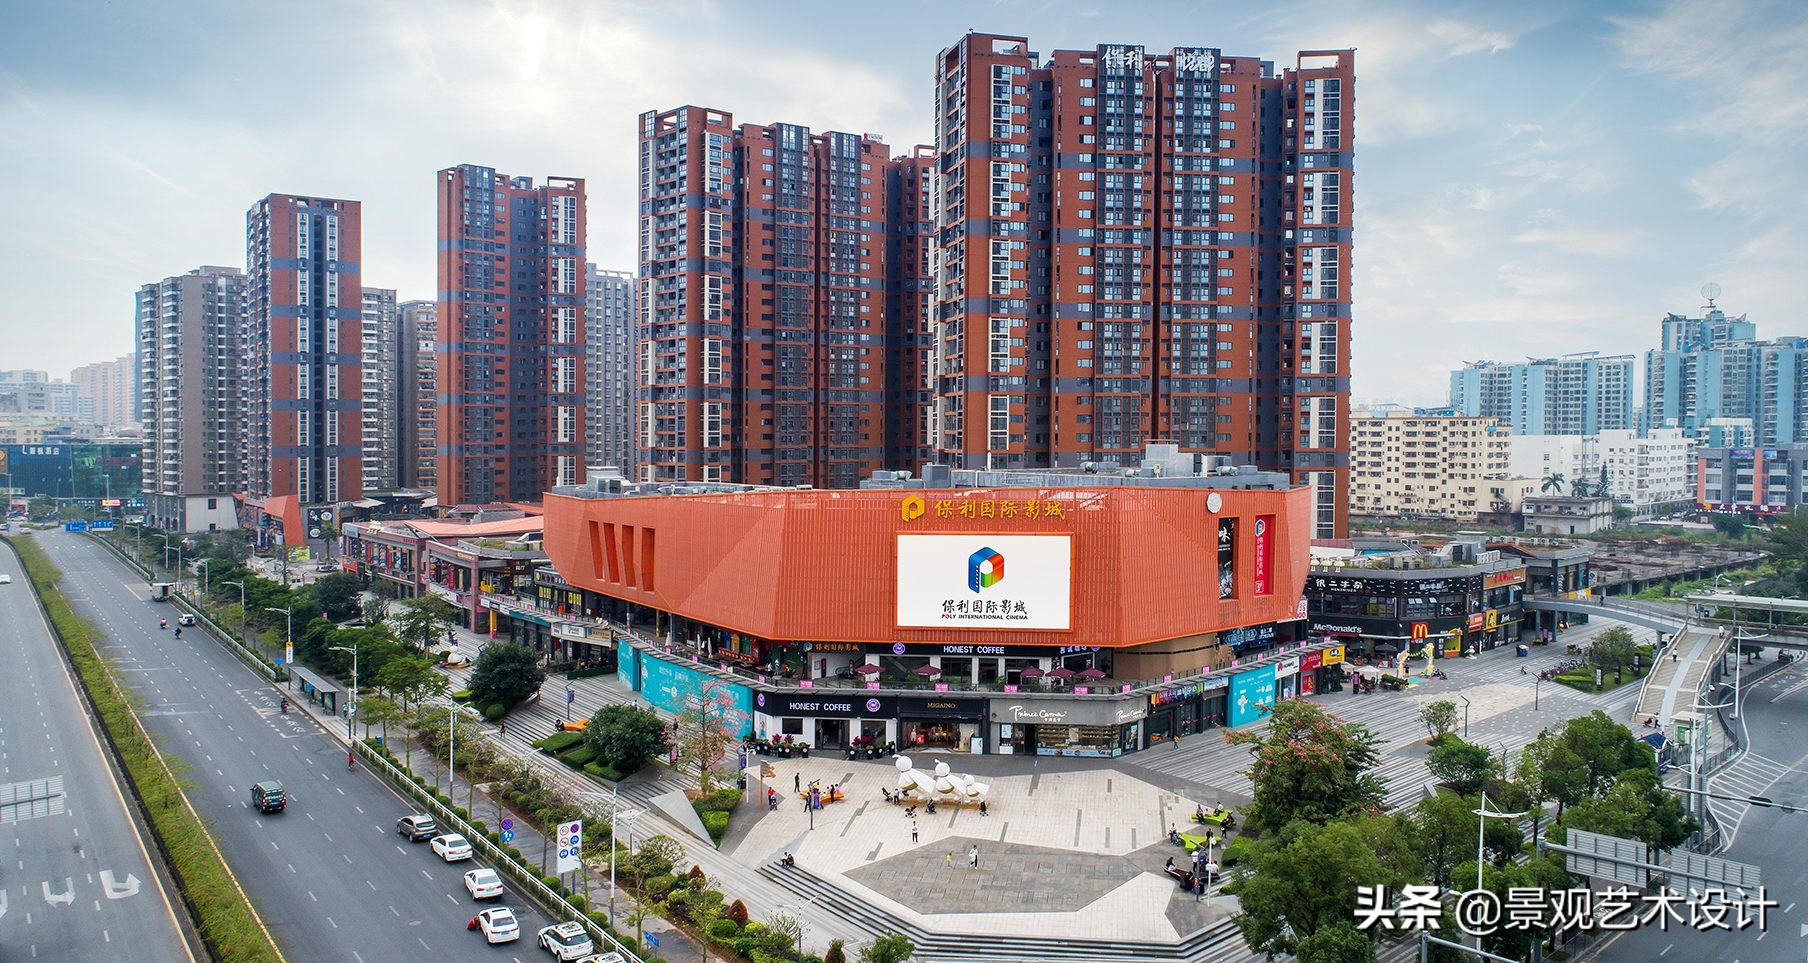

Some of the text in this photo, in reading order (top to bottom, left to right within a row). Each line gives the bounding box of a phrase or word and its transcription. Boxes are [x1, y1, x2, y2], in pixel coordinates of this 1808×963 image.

[934, 499, 1066, 521] 保利国际影城
[941, 599, 1028, 615] 保利国际影城
[1313, 623, 1362, 634] McDonald's
[943, 645, 1005, 654] HONEST COFFEE
[789, 702, 851, 711] HONEST COFFEE
